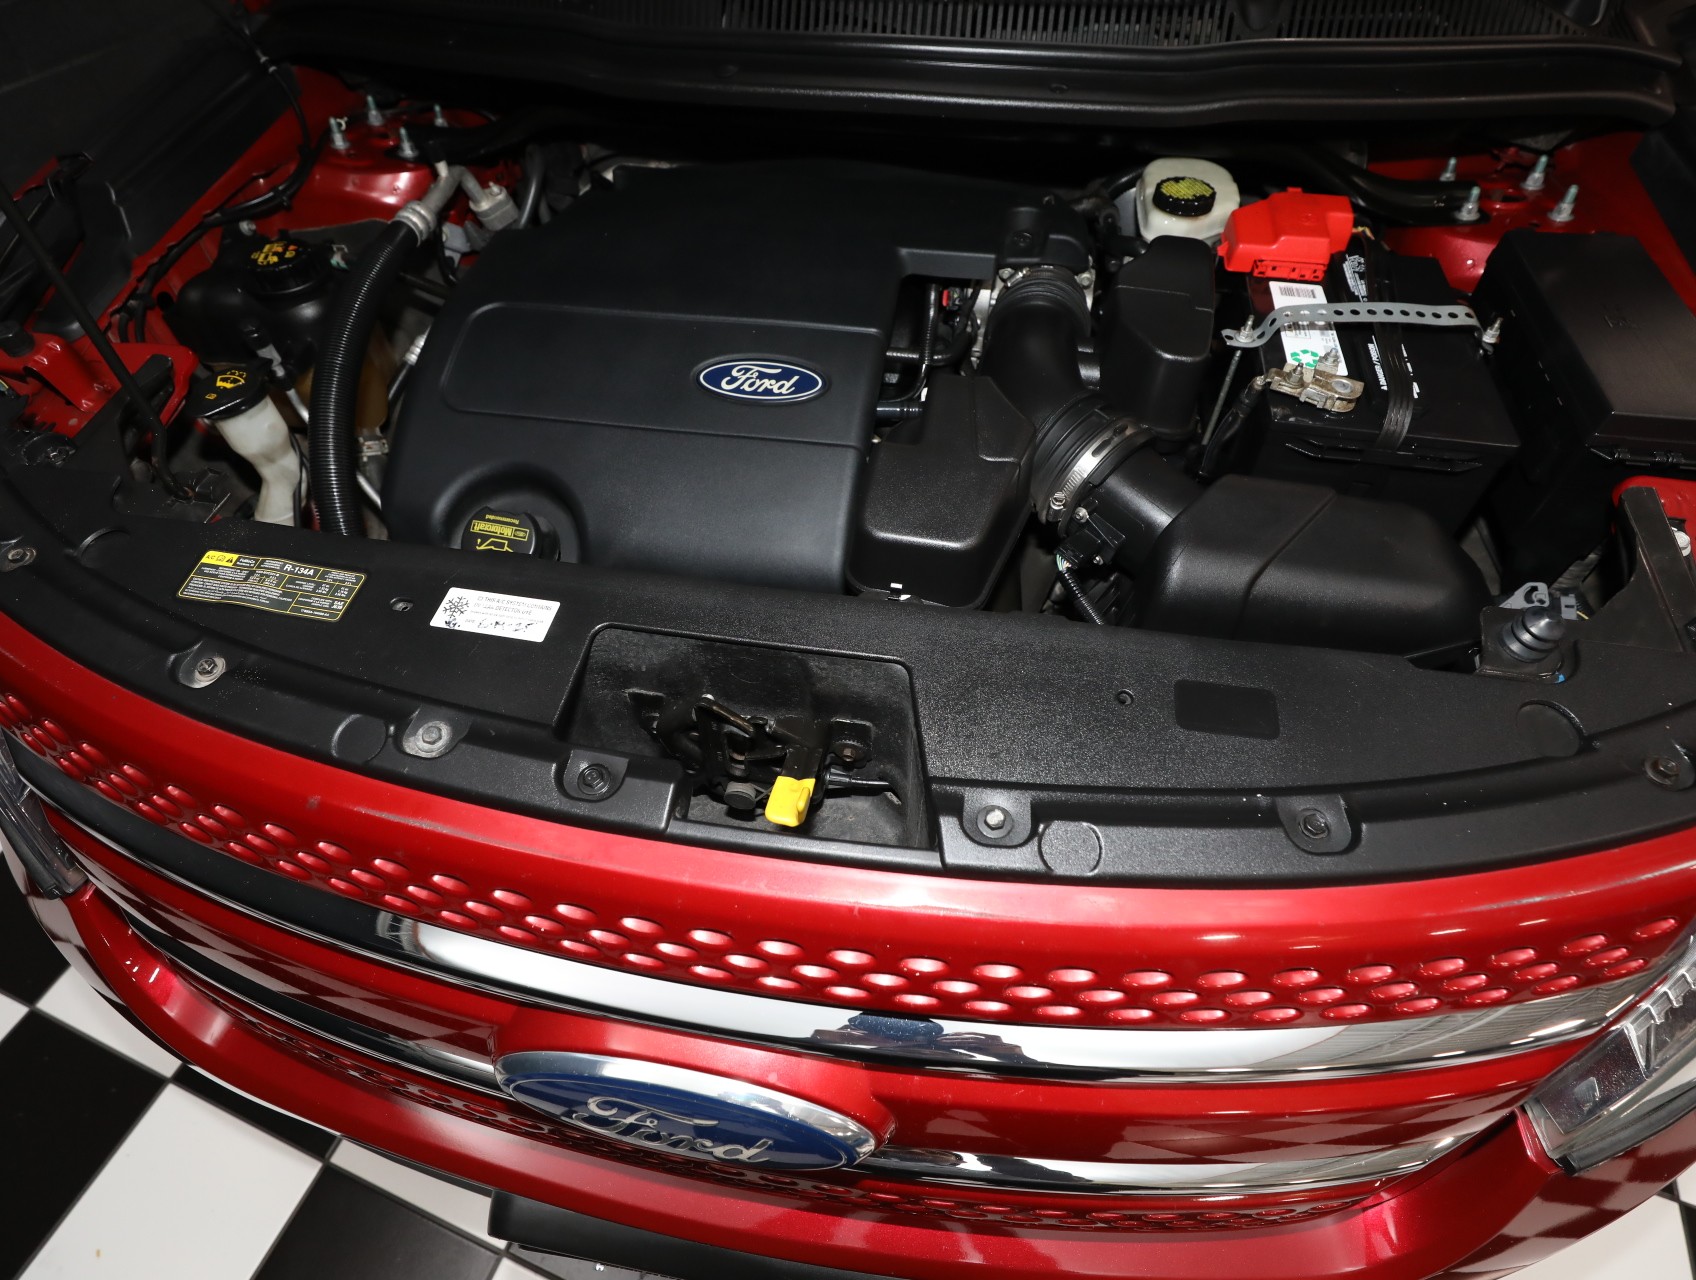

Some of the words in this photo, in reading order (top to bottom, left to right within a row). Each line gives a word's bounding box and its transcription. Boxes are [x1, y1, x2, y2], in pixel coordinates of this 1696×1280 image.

[721, 365, 800, 394] Ford
[485, 514, 520, 524] Recommended
[474, 522, 512, 537] Motorcraft
[283, 563, 315, 576] R-134A
[573, 1096, 774, 1162] Ford
